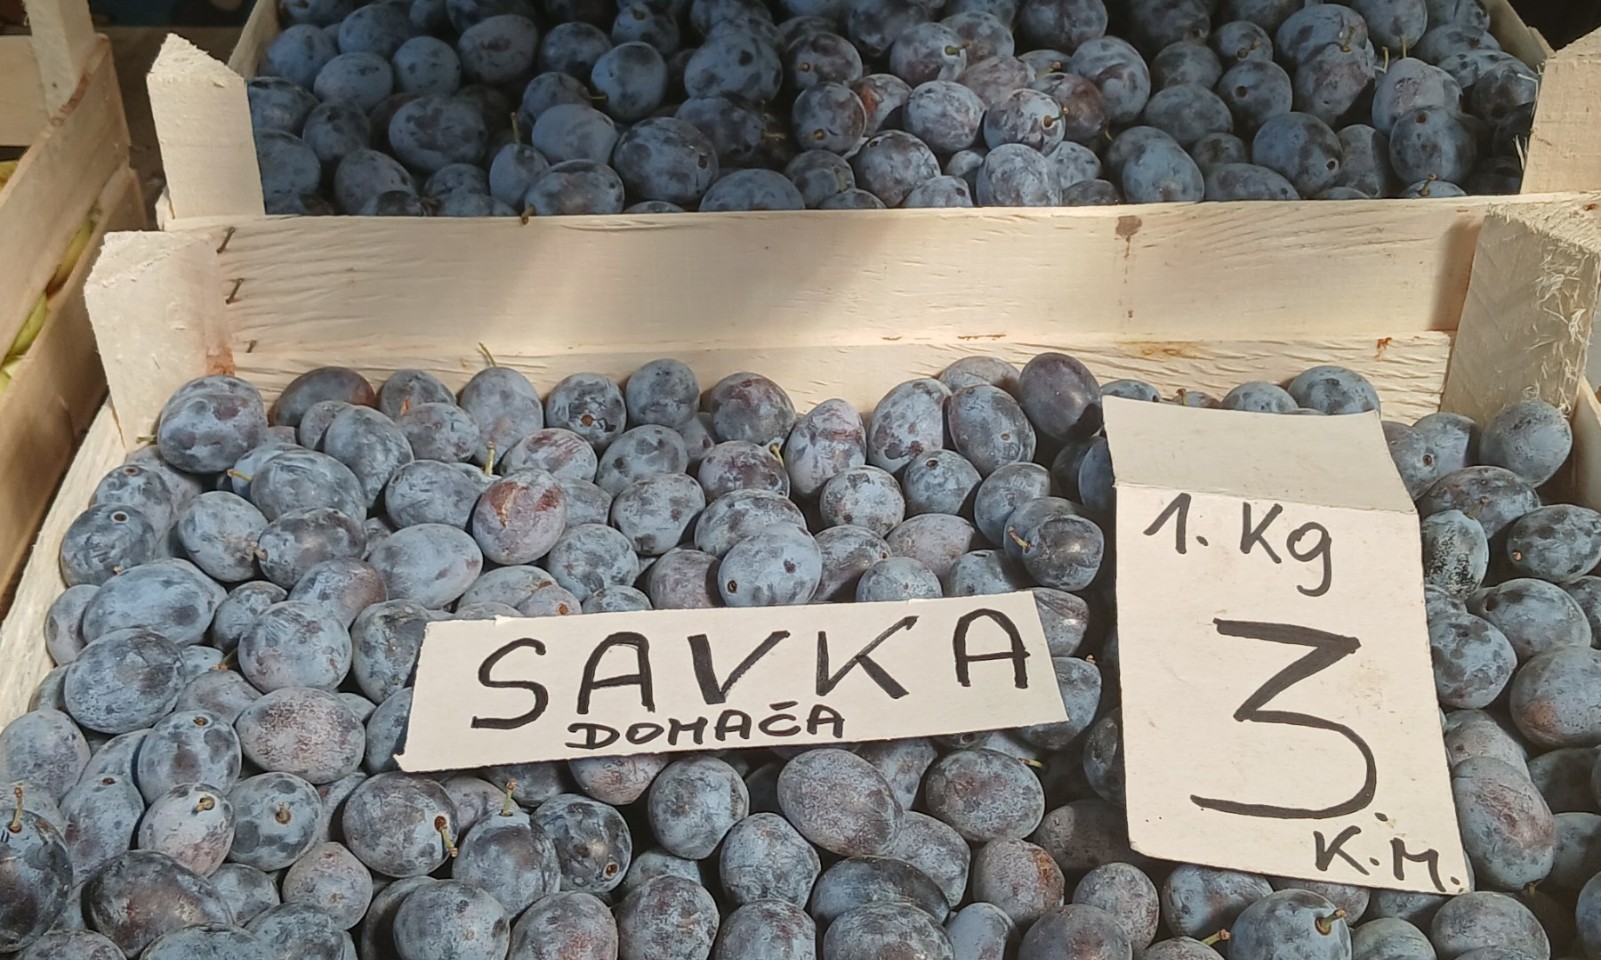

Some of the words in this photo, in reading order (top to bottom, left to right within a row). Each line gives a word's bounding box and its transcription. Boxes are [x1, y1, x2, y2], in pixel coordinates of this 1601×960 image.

[1239, 501, 1333, 598] Kg
[470, 608, 1031, 731] SAVKA
[1312, 825, 1463, 894] K.M.
